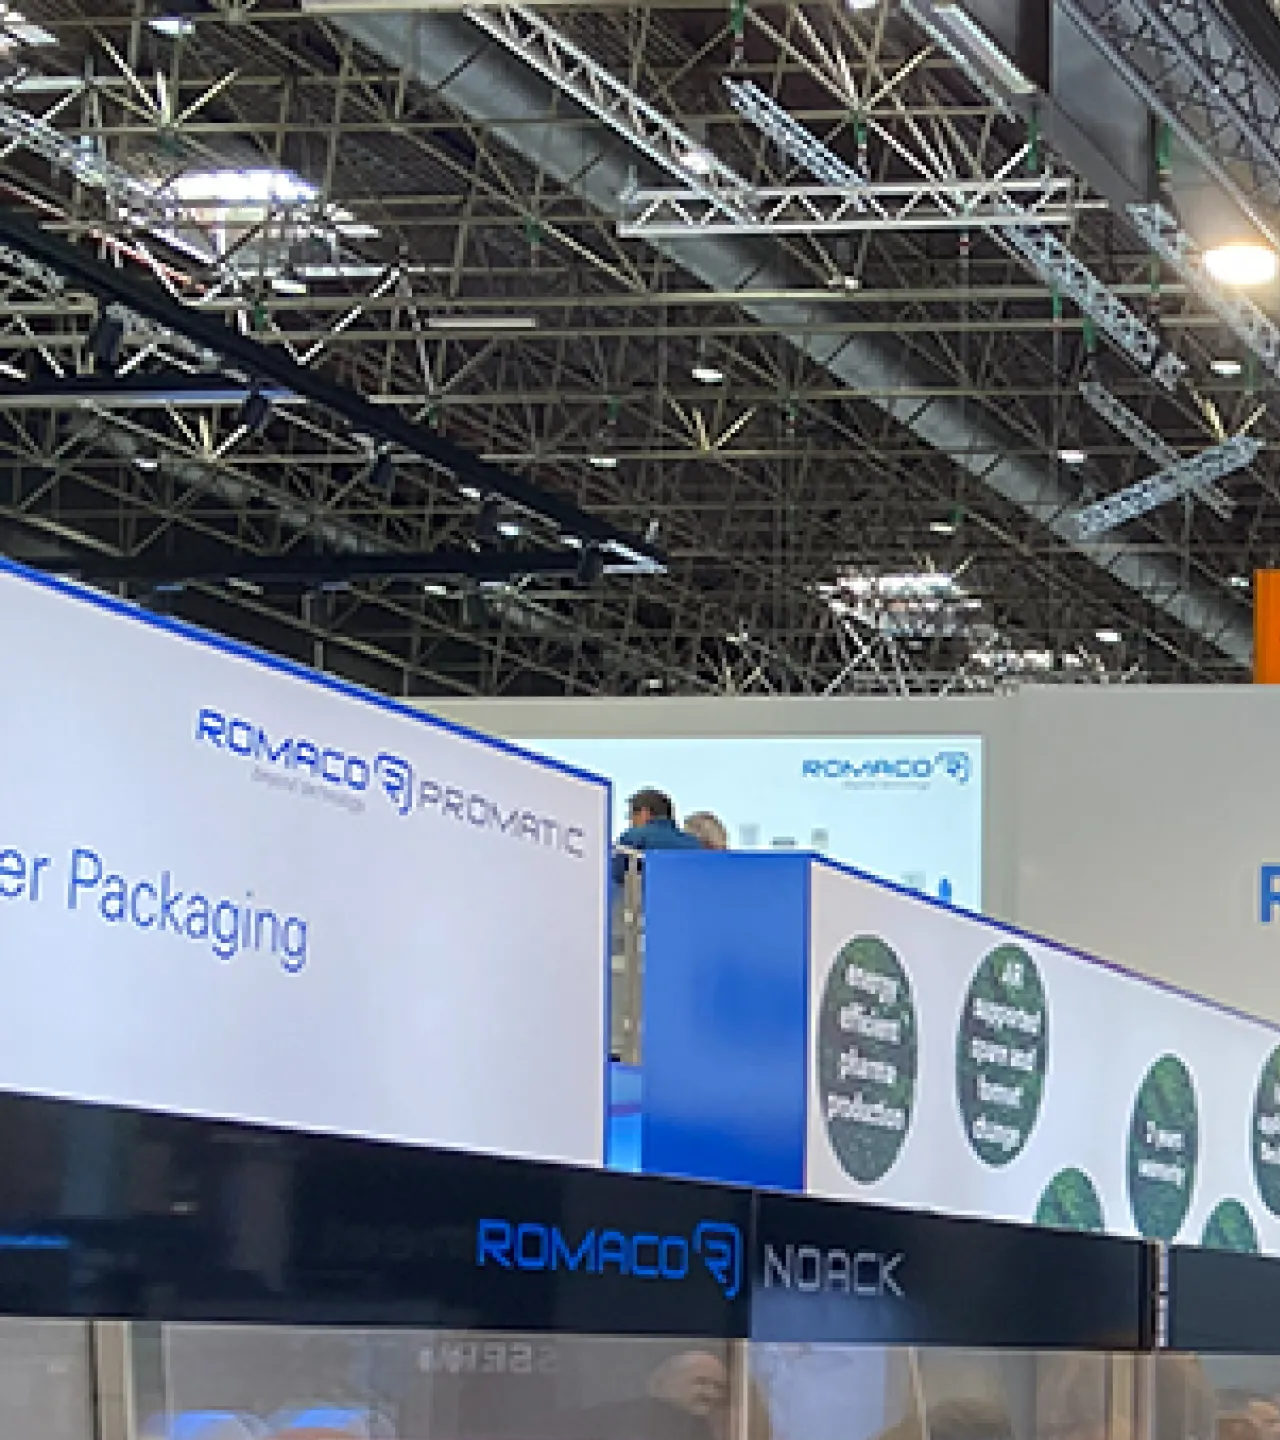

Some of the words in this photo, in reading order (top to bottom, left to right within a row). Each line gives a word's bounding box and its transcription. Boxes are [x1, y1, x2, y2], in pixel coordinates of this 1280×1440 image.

[195, 708, 369, 790] ROMACO
[417, 781, 585, 859] PROMATIC
[803, 759, 931, 778] ROMACO
[68, 848, 307, 974] Packaging
[476, 1218, 689, 1280] ROMACO
[763, 1243, 905, 1297] NOACK
